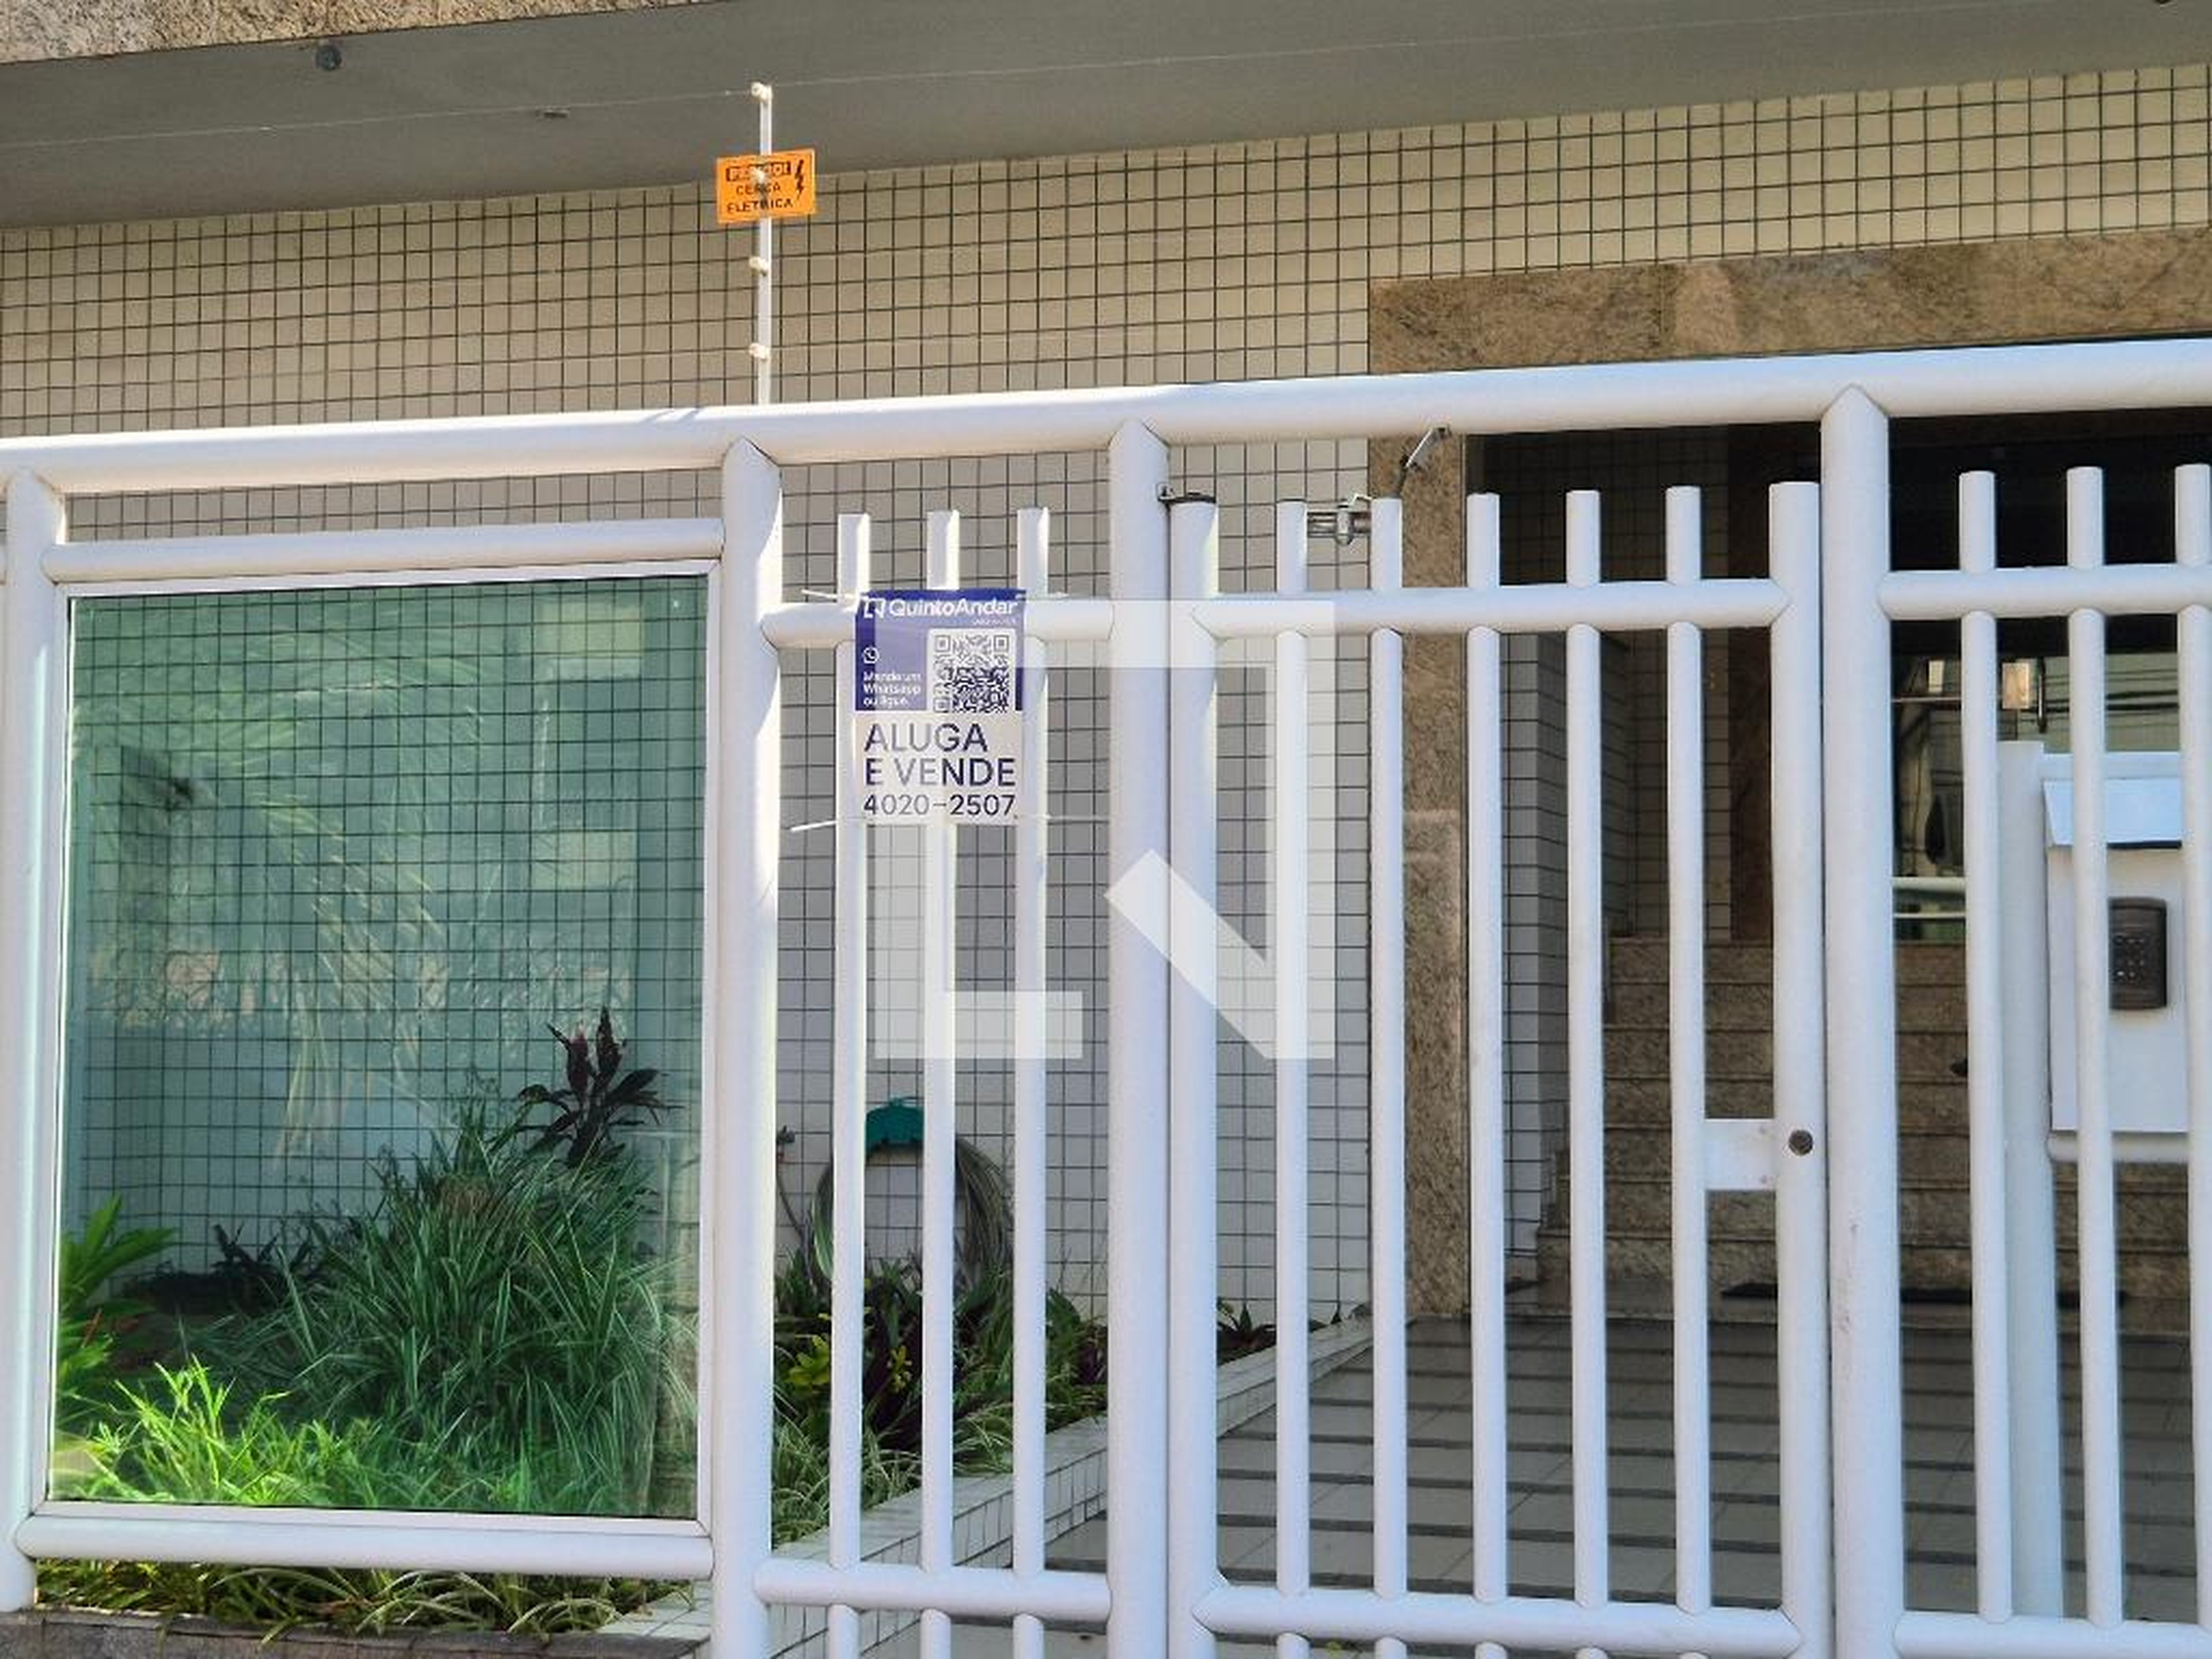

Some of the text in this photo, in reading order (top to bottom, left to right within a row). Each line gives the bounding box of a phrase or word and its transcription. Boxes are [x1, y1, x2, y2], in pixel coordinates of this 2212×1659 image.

[889, 597, 1018, 616] QuintoAndar
[864, 723, 988, 752] ALUGA
[865, 757, 1016, 786] E VENDE
[863, 794, 1016, 816] 4020-2507
